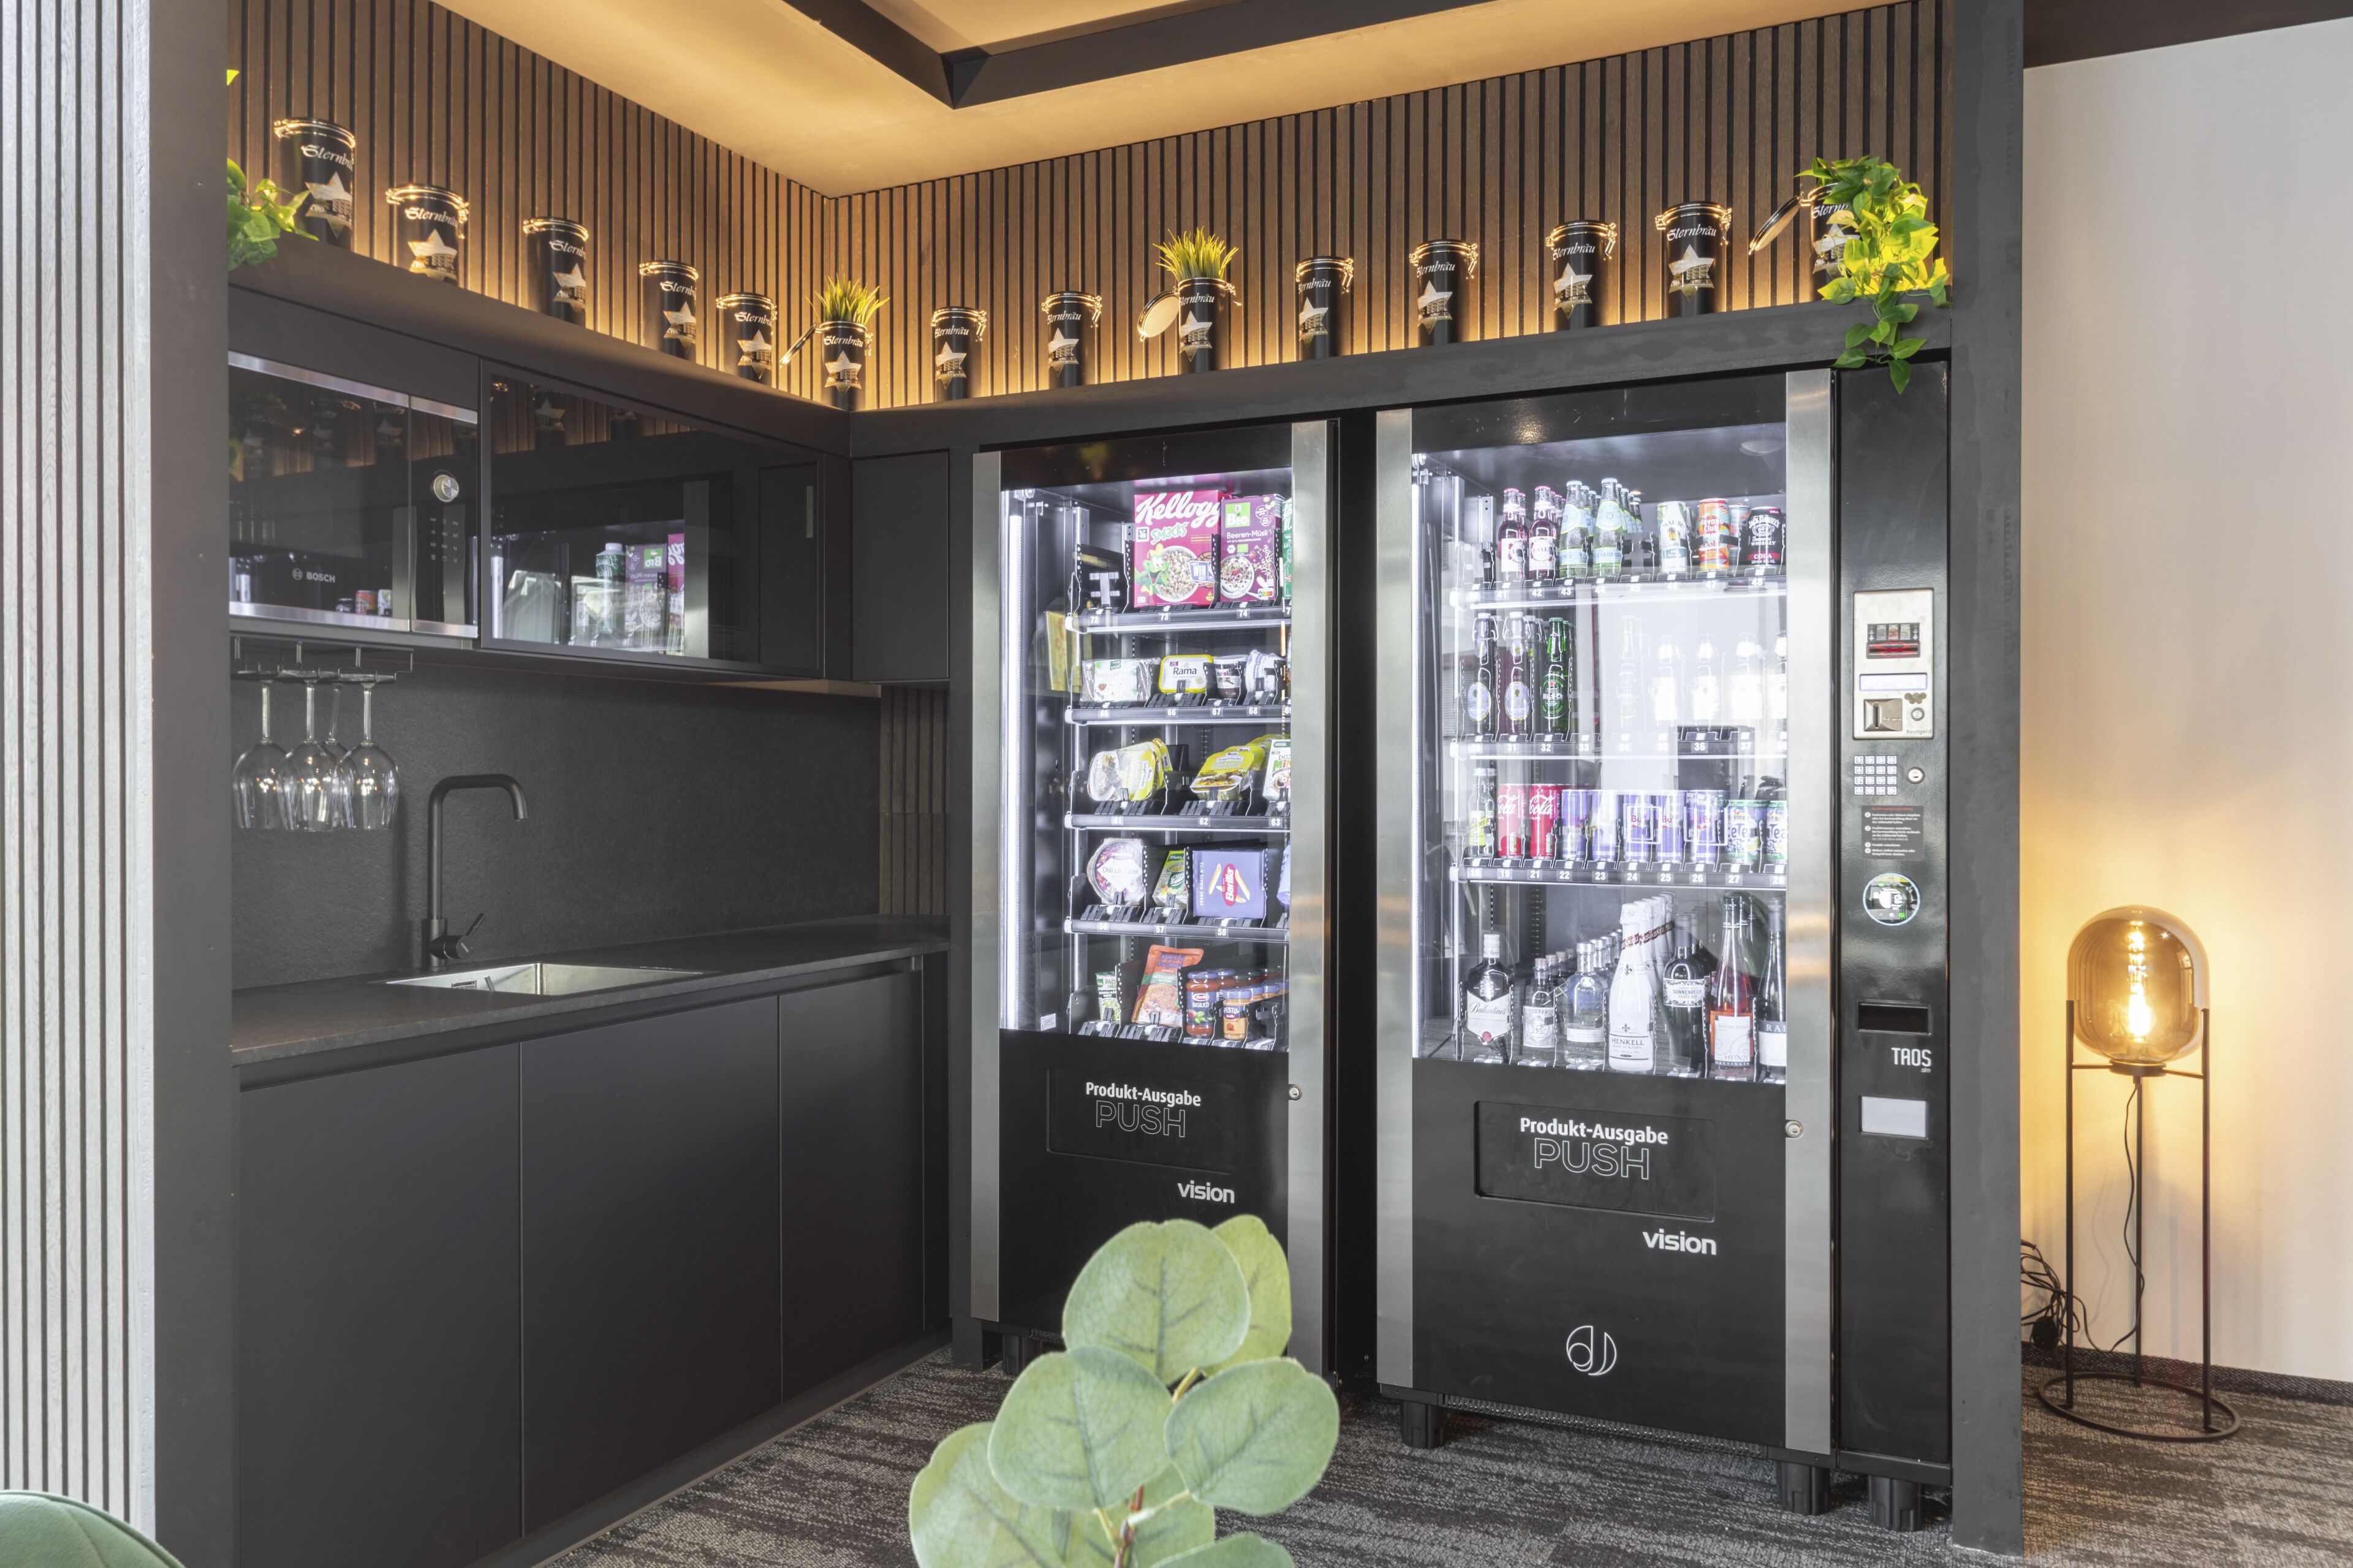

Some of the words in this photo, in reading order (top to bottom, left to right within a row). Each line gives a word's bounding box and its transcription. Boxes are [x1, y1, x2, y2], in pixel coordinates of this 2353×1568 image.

[1666, 223, 1717, 241] Sternbräu
[824, 335, 863, 347] Sternbräu
[1227, 513, 1249, 525] Bio
[1227, 529, 1268, 539] Beeren-Müsli
[306, 572, 335, 583] BOSCH
[1740, 742, 1751, 751] 37
[1226, 868, 1234, 902] Barilla
[1627, 873, 1638, 881] 24
[1773, 876, 1784, 884] 28
[1891, 1047, 1931, 1067] TAOS
[1086, 1081, 1201, 1107] Produkt-Ausgabe
[1096, 1100, 1186, 1138] PUSH
[1520, 1117, 1668, 1146] Produkt-Ausgabe
[1534, 1138, 1650, 1180] PUSH
[1178, 1180, 1235, 1203] vision
[1643, 1229, 1716, 1256] vision
